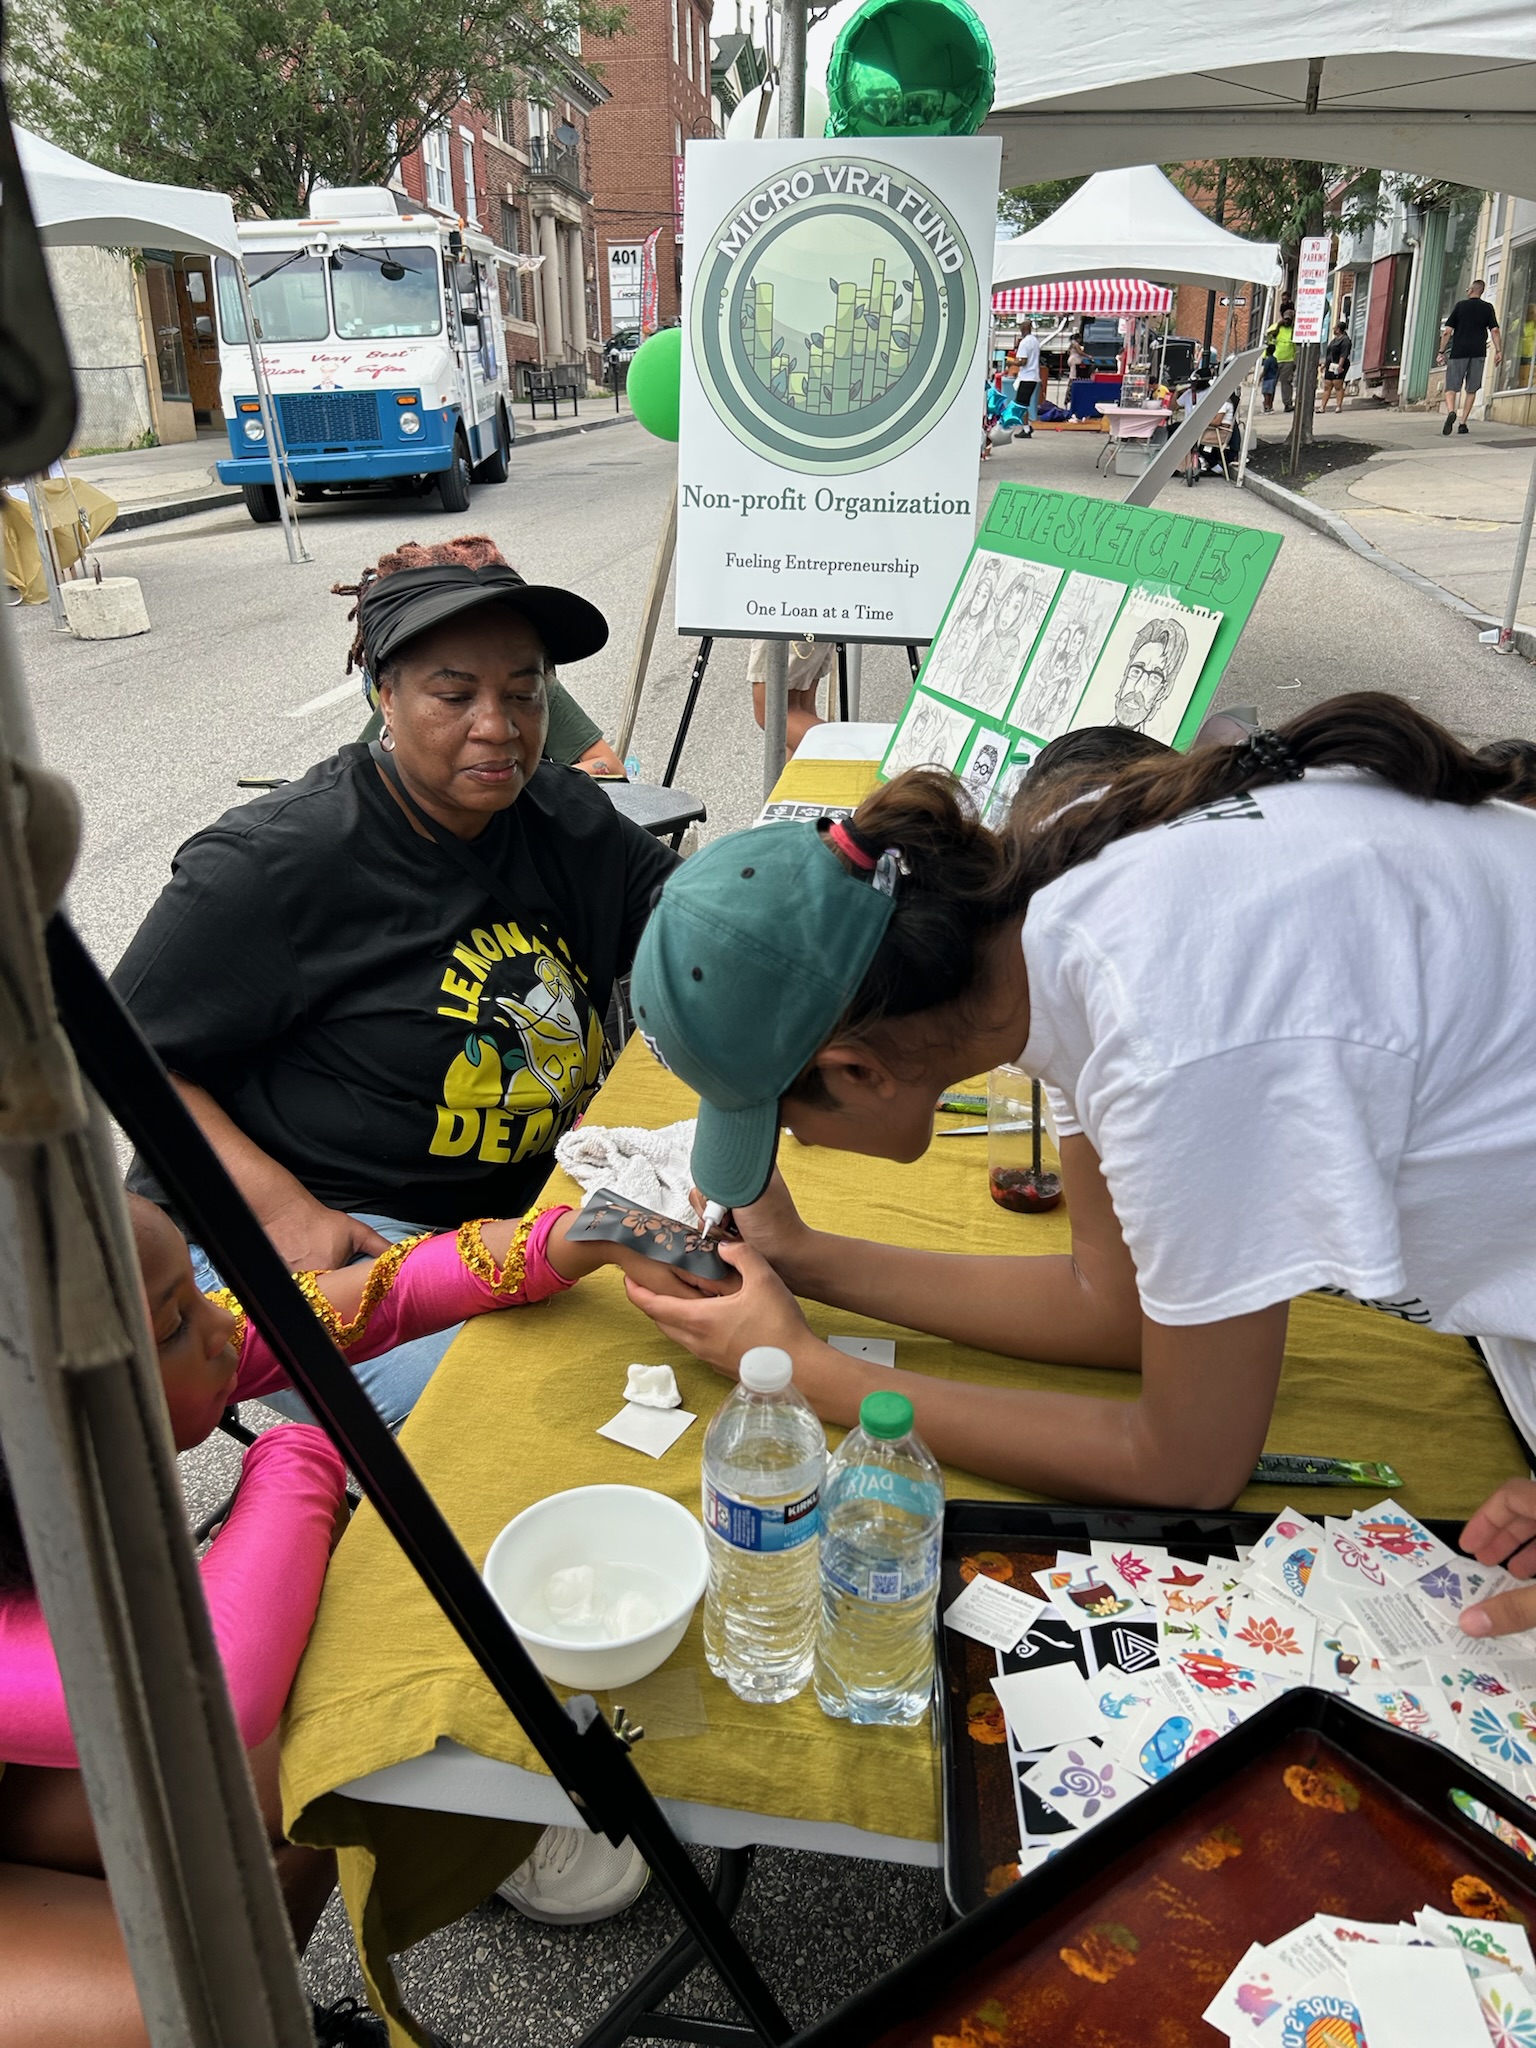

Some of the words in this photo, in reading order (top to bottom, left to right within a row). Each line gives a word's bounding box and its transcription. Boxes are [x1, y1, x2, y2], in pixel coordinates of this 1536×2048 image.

[716, 169, 815, 261] MICRO
[820, 165, 893, 205] VRA
[895, 185, 965, 275] FUND
[611, 249, 637, 265] 401
[1311, 241, 1321, 251] NO
[1303, 253, 1327, 263] PARKING
[1301, 269, 1325, 278] DRIVEWAY
[311, 354, 352, 364] Very
[682, 484, 807, 517] Non-profit
[814, 486, 972, 520] Organization
[984, 488, 1063, 545] LIVE
[1053, 496, 1265, 605] SKETCHES
[725, 552, 782, 574] Fueling
[785, 553, 920, 578] Entrepreneurship
[746, 599, 777, 617] One
[780, 601, 818, 618] Loan
[822, 604, 838, 619] at
[841, 608, 850, 620] a
[854, 604, 894, 621] Time
[787, 1493, 819, 1517] KIRKL
